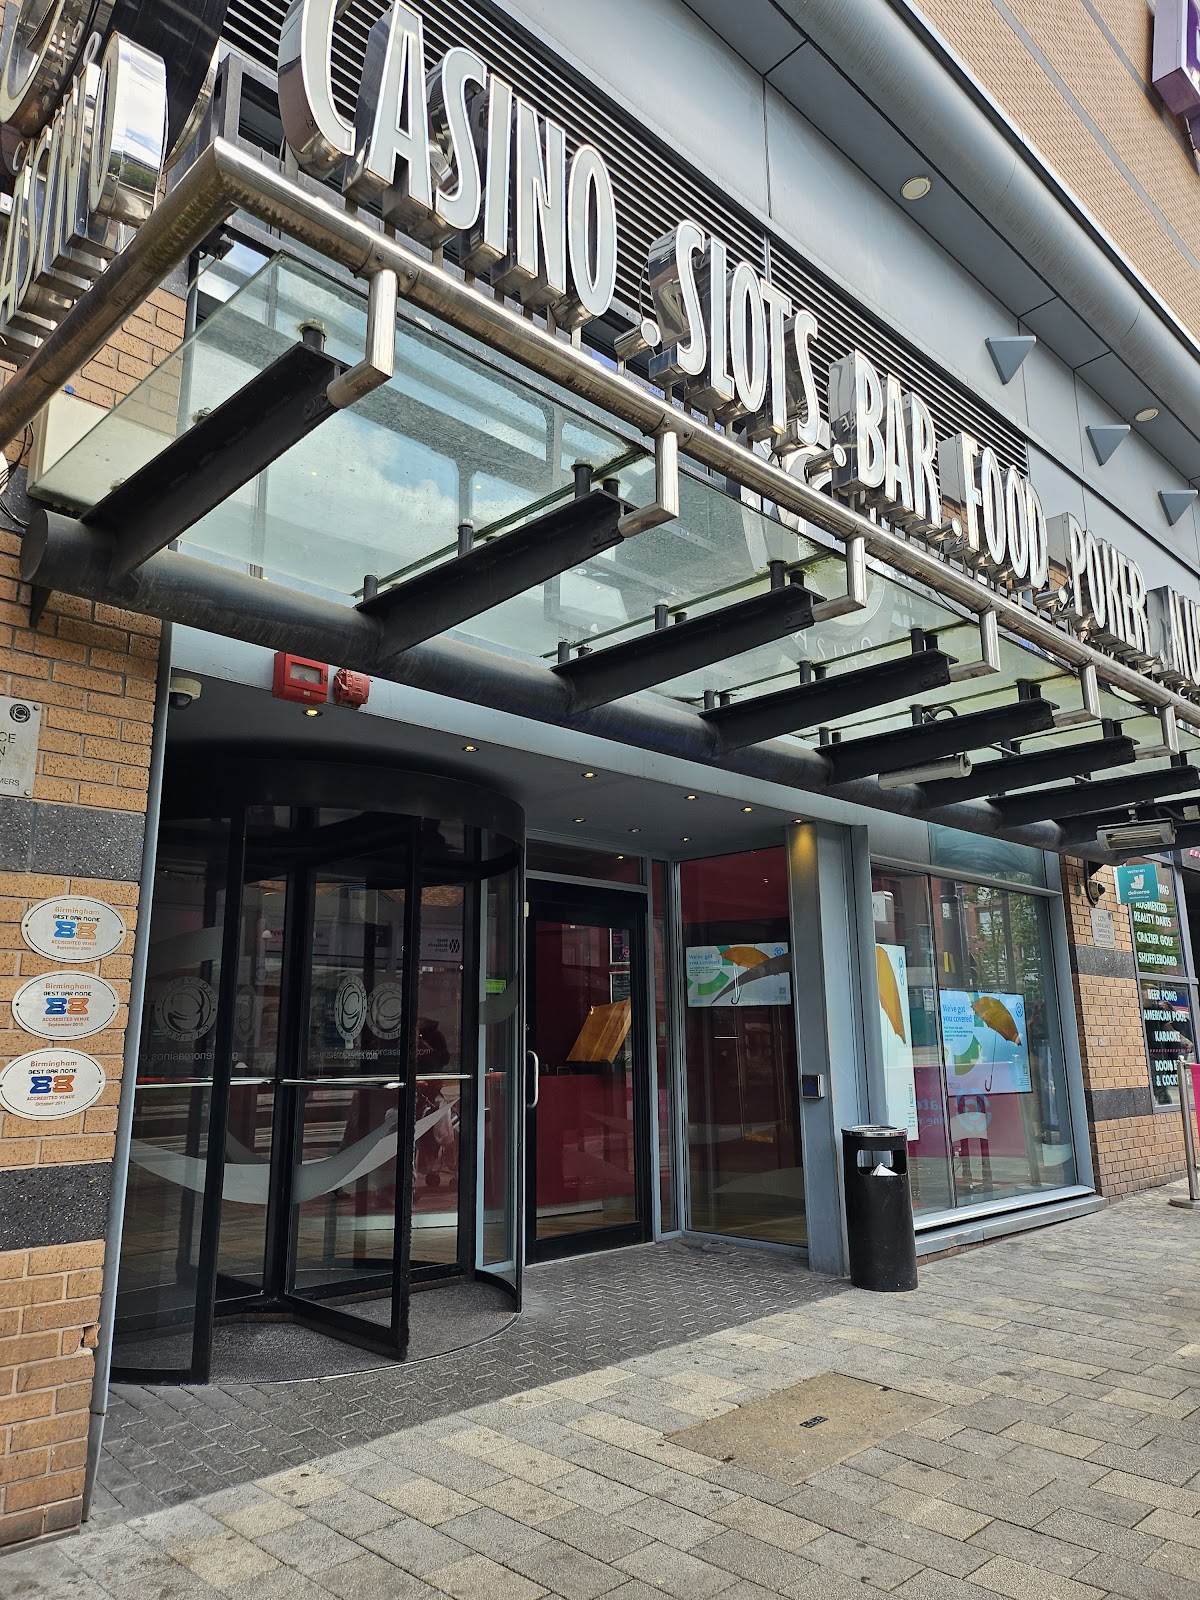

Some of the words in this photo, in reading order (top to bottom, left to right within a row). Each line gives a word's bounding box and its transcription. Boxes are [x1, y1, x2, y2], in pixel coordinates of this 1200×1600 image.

[298, 0, 618, 318] CASINO
[676, 219, 820, 447] SLOTS
[854, 349, 942, 533] BAR
[960, 432, 1050, 590] FOOD
[1067, 512, 1151, 656] POKER
[54, 906, 100, 916] Birmingham
[1133, 911, 1155, 925] REALITY
[1155, 914, 1172, 928] DARTS
[1136, 931, 1160, 944] CRAZIER
[1160, 934, 1173, 946] GOLF
[1138, 952, 1177, 966] SHUFFLEBOARD
[45, 982, 91, 991] Birmingham
[1147, 989, 1160, 1000] BEER
[1161, 990, 1178, 1002] PONG
[957, 1005, 966, 1015] got
[1143, 1009, 1171, 1021] AMERICAN
[1172, 1011, 1187, 1022] POOL
[943, 1016, 953, 1025] you
[953, 1015, 973, 1023] covered
[1154, 1031, 1181, 1042] KARAOKE
[30, 1060, 77, 1068] Birmingham
[1154, 1060, 1174, 1072] BOOM
